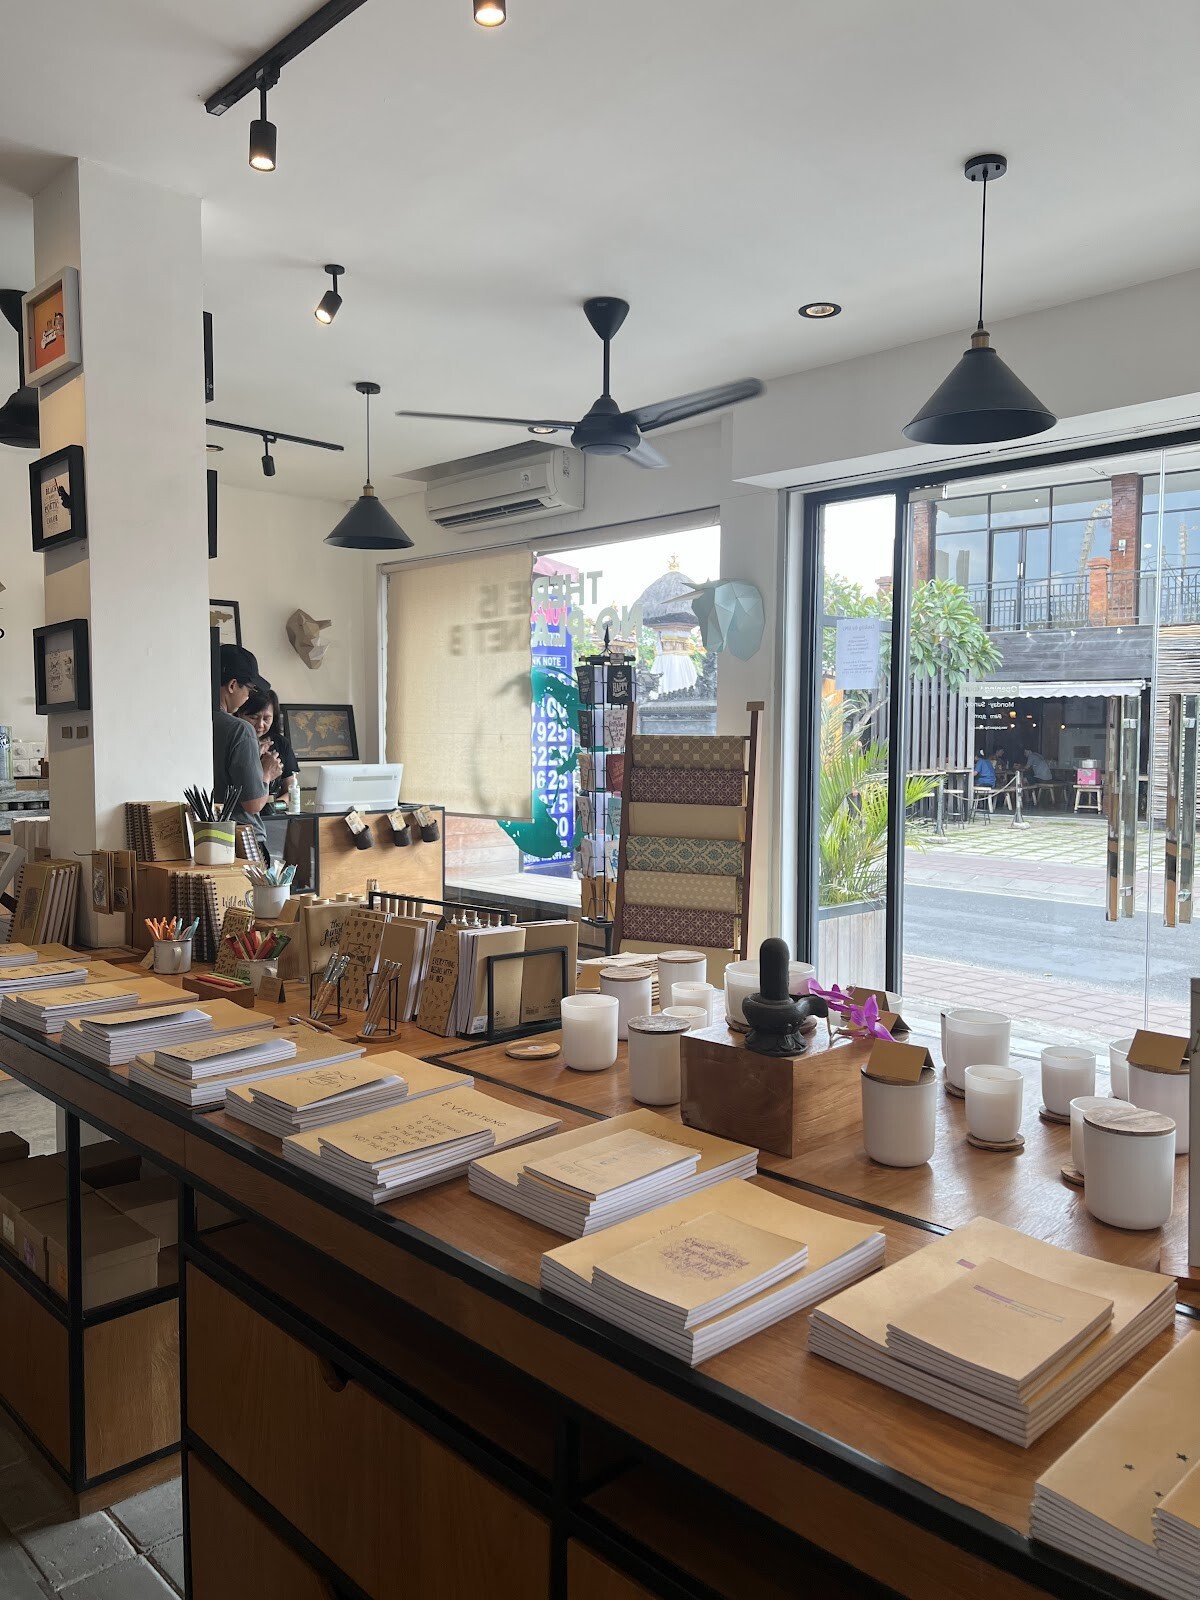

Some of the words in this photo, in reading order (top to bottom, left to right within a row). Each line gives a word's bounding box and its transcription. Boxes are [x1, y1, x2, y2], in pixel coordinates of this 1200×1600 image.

[542, 656, 562, 667] NOTE
[422, 1114, 461, 1134] EVERYTHING
[441, 1101, 507, 1127] EVERYTHING
